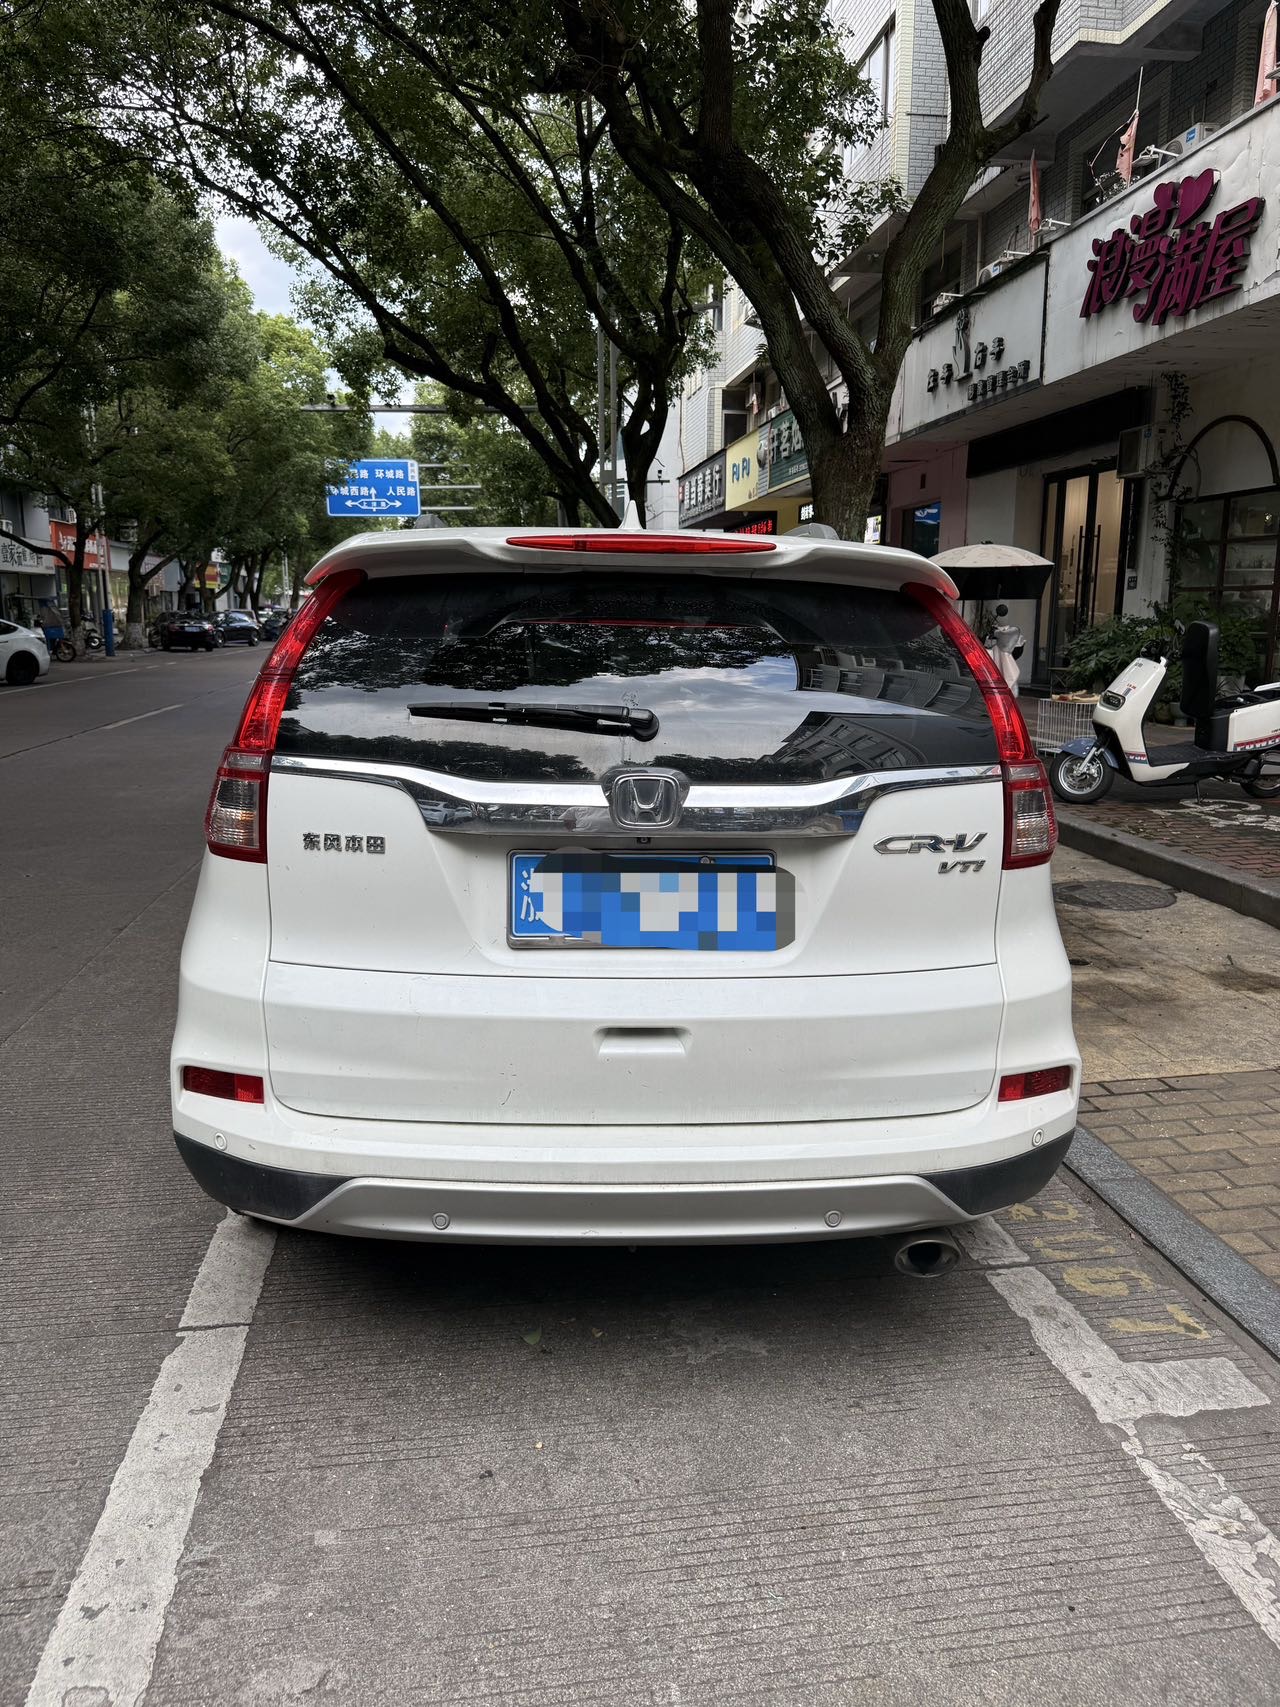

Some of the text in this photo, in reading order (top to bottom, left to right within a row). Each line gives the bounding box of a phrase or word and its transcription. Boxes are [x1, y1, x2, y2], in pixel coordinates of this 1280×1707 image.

[1080, 180, 1266, 325] 浪漫满屋
[374, 469, 404, 479] 环城路
[387, 486, 416, 496] 人民路
[303, 833, 385, 854] 东风本田
[873, 832, 988, 854] CR-V
